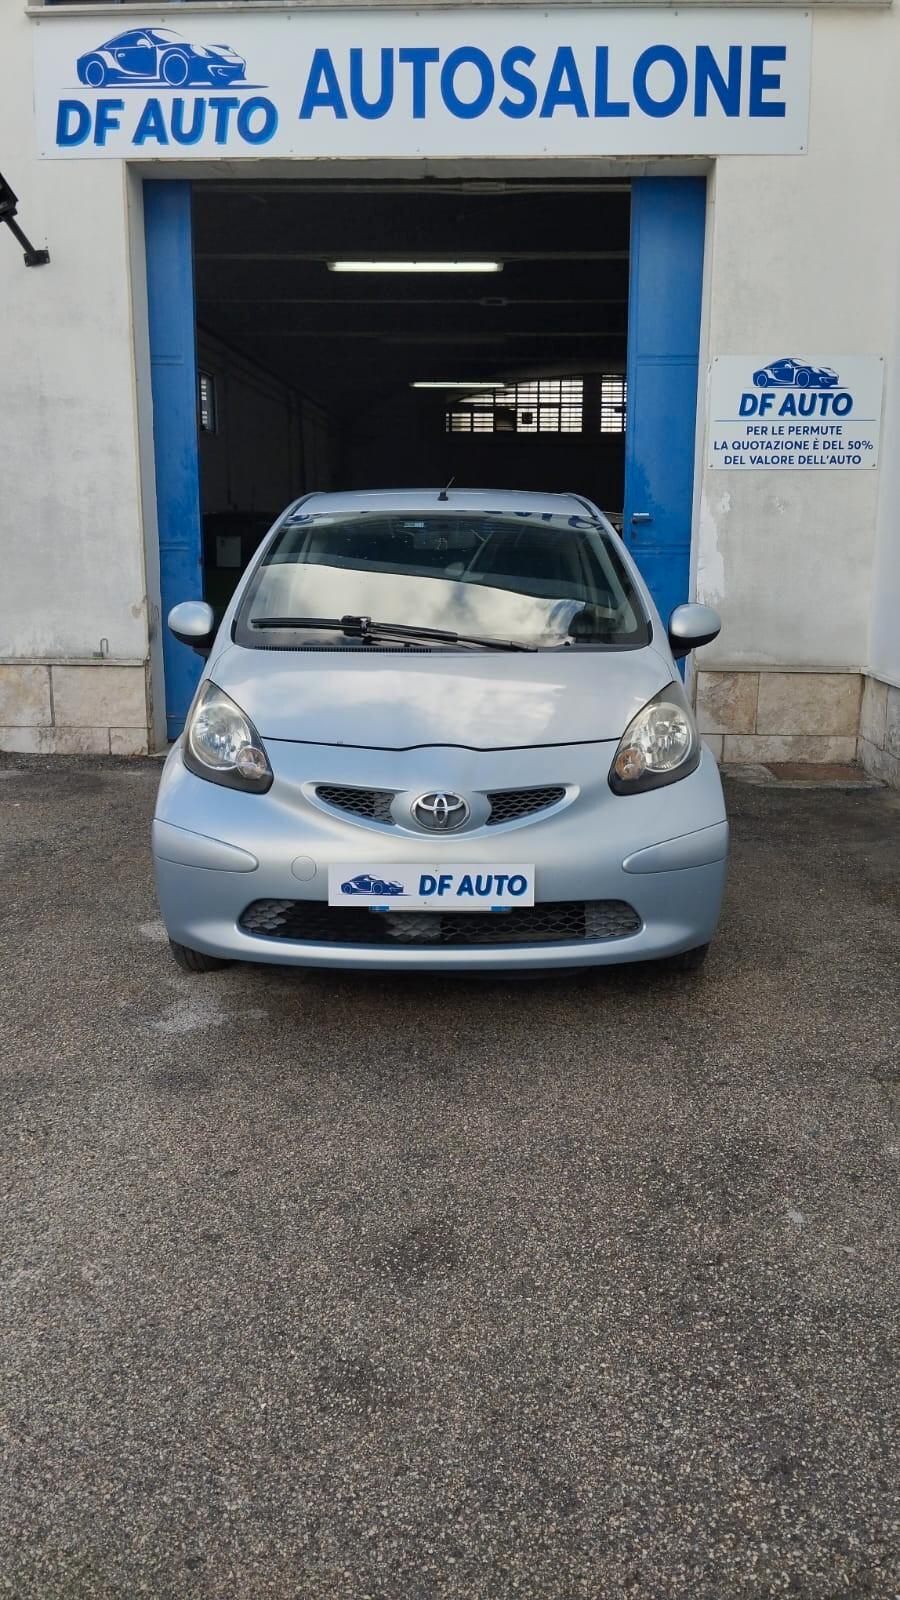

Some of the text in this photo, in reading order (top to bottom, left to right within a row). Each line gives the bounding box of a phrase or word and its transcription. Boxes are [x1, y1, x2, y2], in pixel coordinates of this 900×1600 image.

[298, 44, 787, 120] AUTOSALONE
[56, 96, 279, 147] DF AUTO
[738, 392, 853, 417] DF AUTO
[746, 425, 843, 436] PER LE PERMUTE
[714, 437, 874, 450] LA QUOTAZIONE È DEL 50%
[724, 454, 862, 465] DEL VALORE DELL'AUTO
[418, 874, 528, 897] DF AUTO
